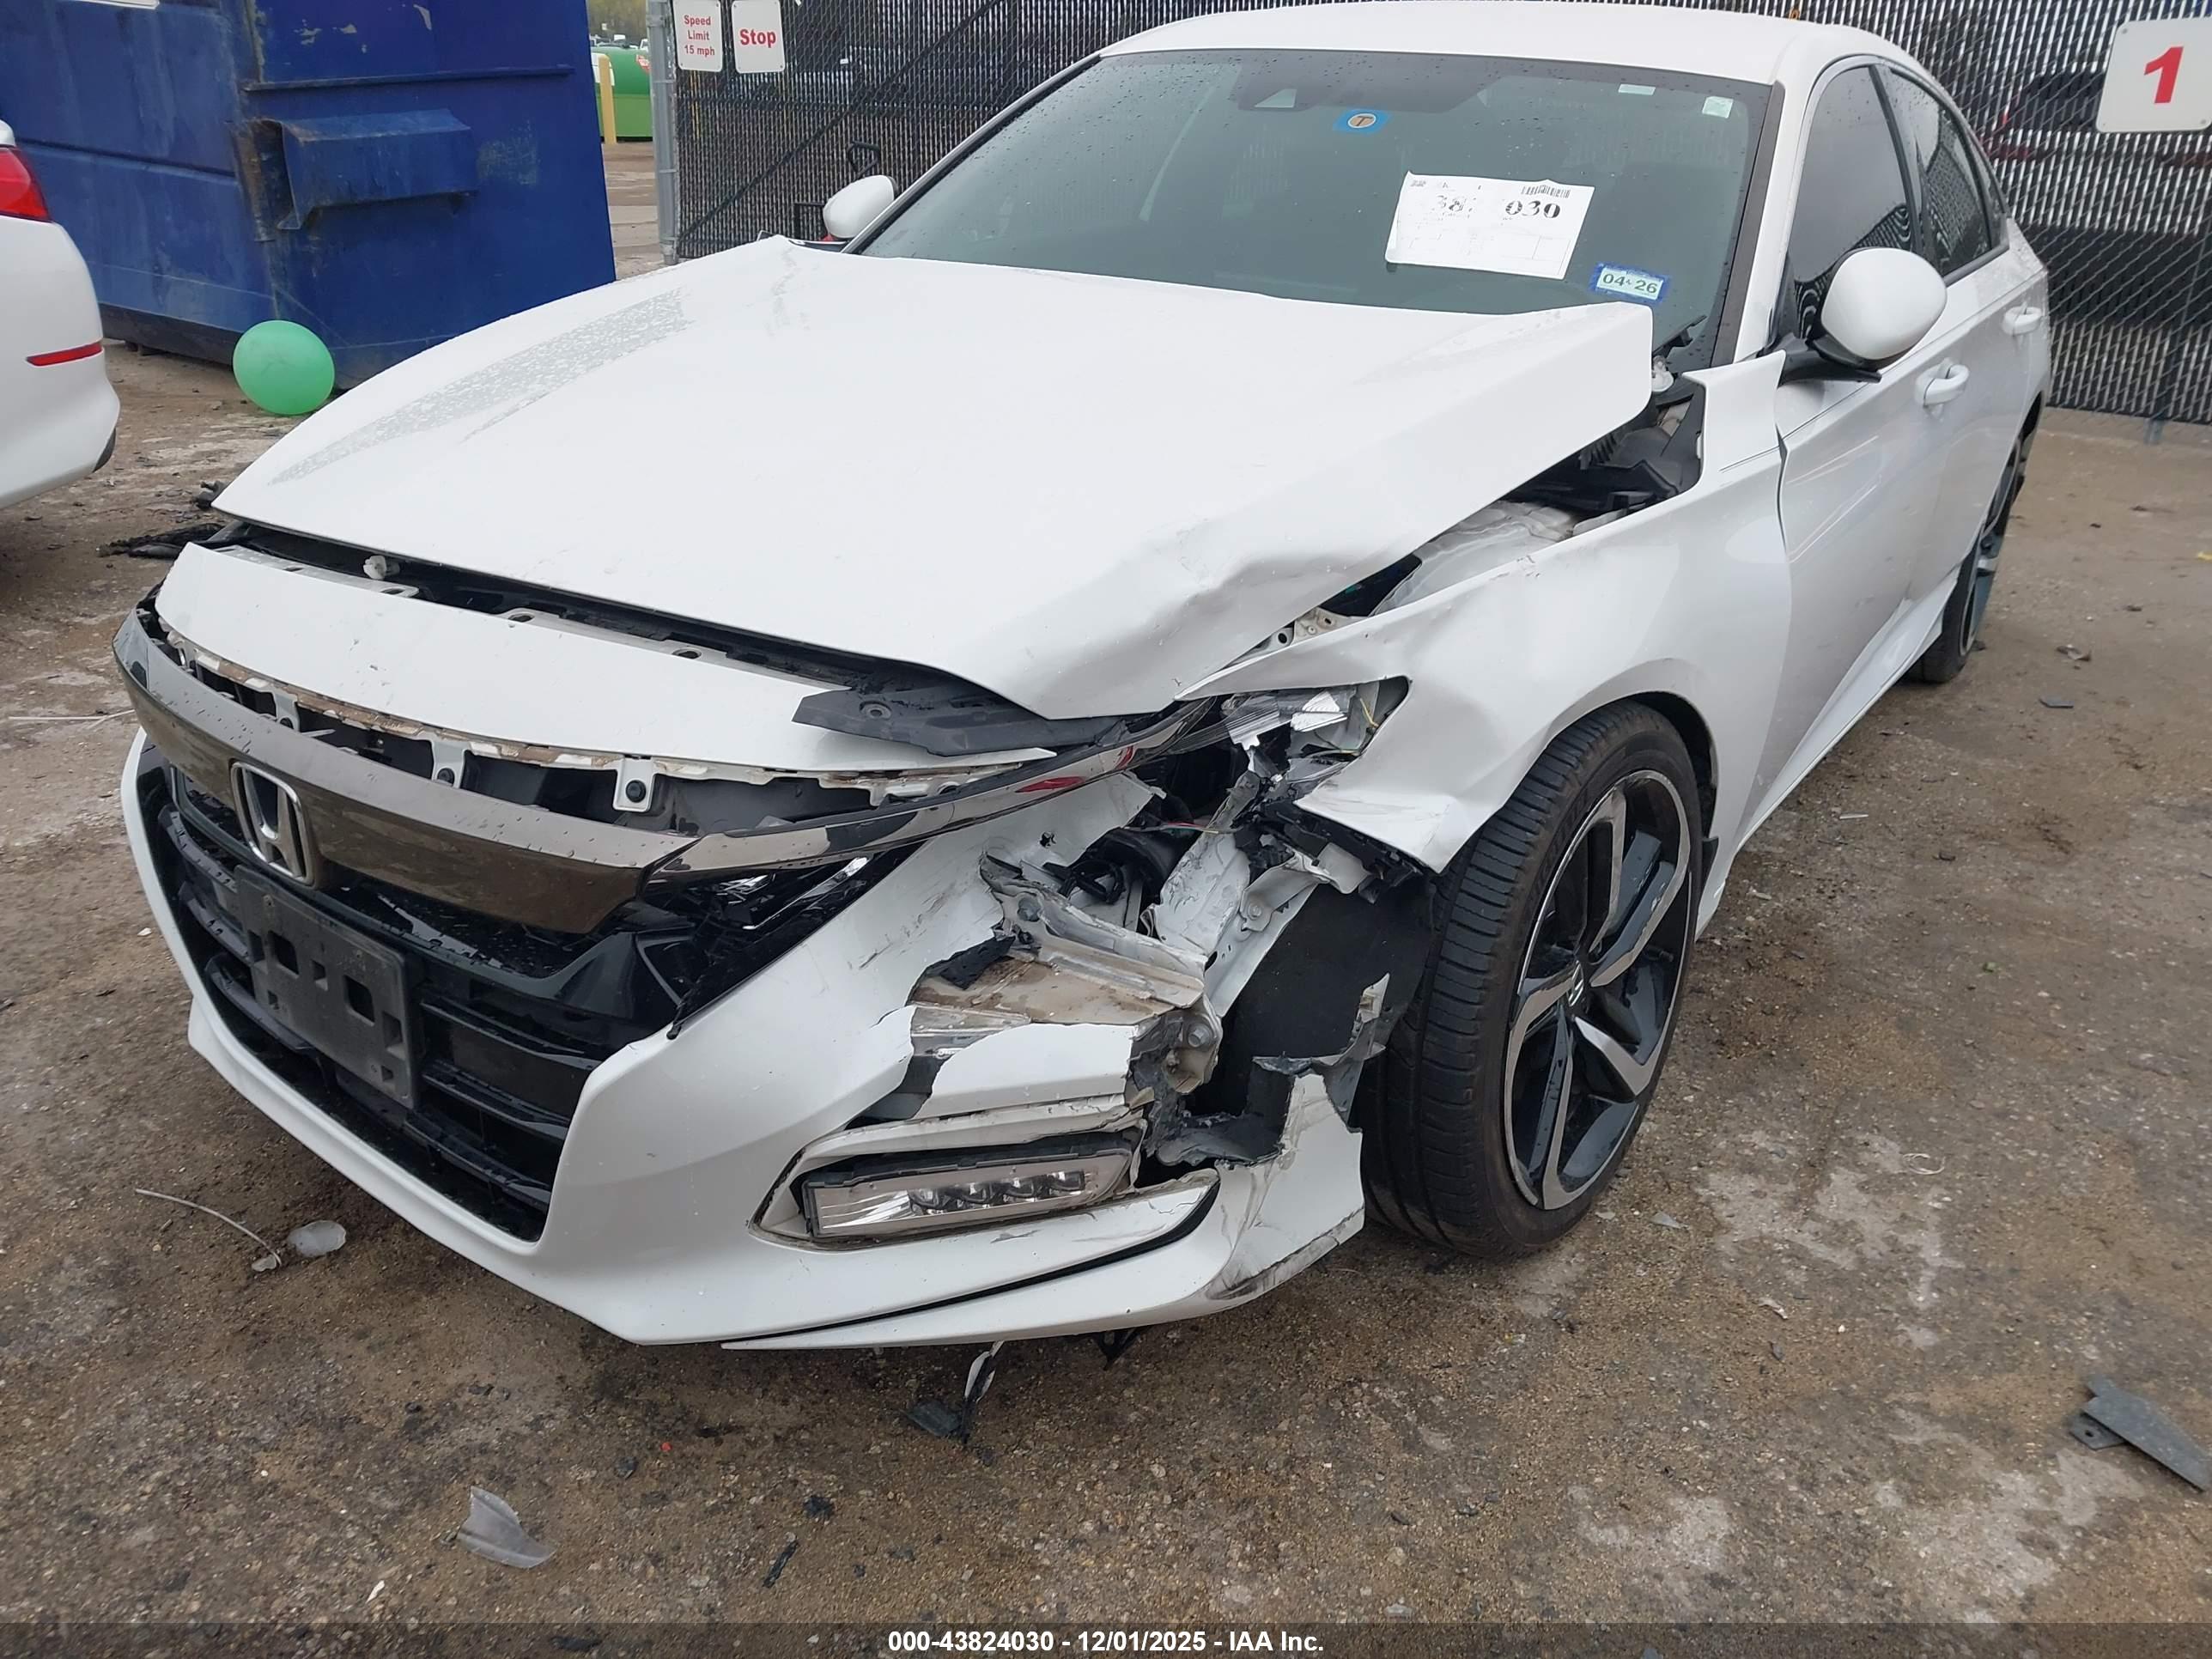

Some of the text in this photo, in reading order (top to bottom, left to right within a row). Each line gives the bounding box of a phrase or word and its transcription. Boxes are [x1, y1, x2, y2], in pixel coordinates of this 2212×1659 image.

[684, 15, 712, 27] Speed
[688, 30, 710, 41] Limit
[739, 28, 776, 48] Stop
[684, 45, 715, 58] 15 mph
[2144, 46, 2184, 104] 1
[1602, 273, 1658, 294] 04 26
